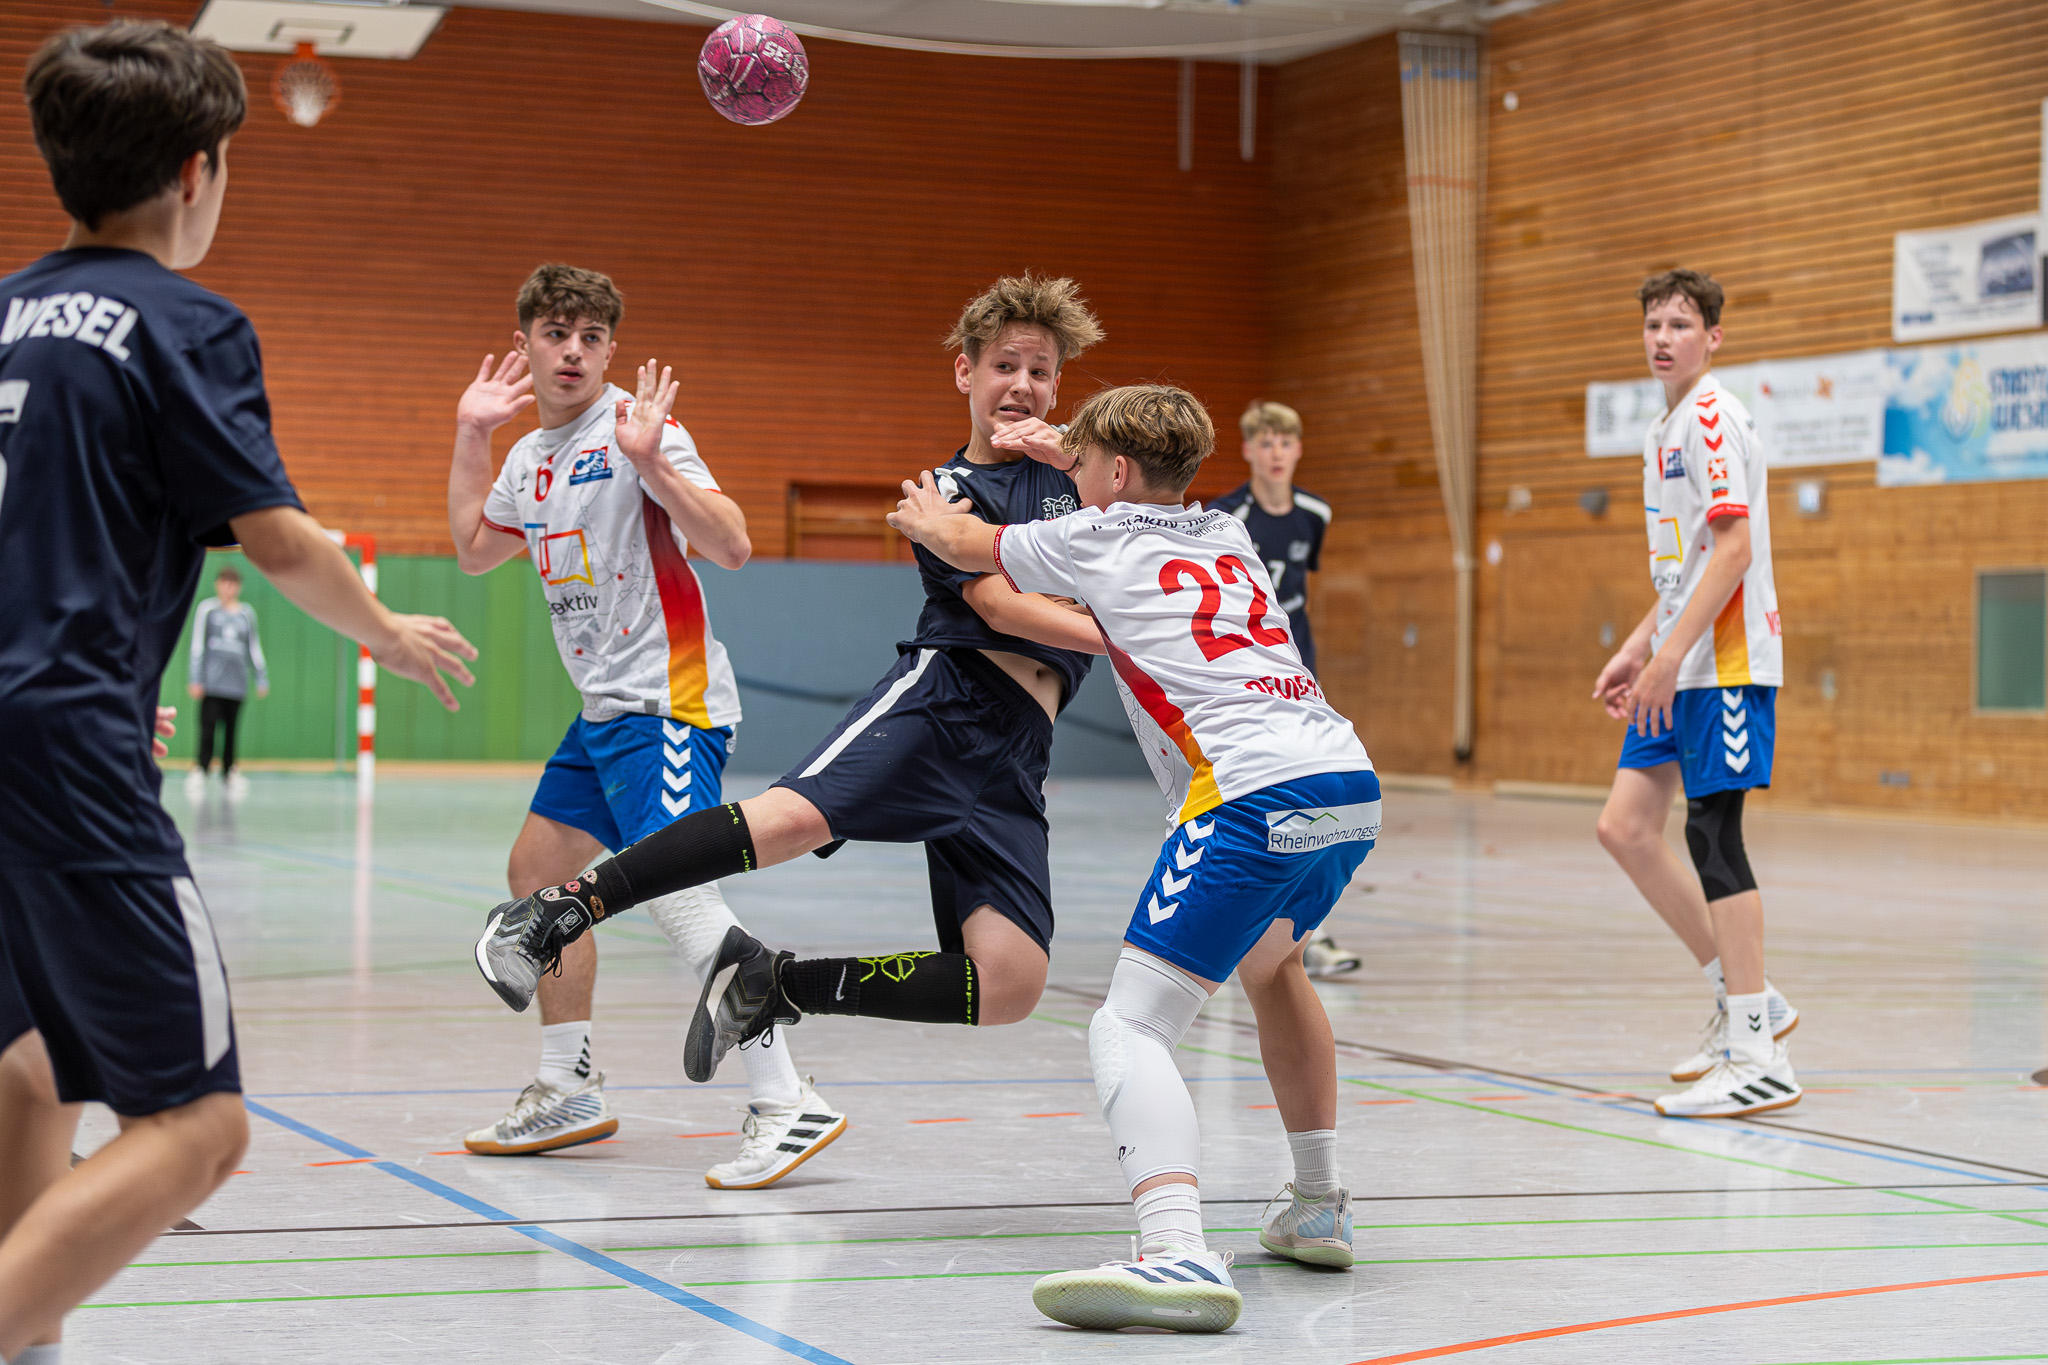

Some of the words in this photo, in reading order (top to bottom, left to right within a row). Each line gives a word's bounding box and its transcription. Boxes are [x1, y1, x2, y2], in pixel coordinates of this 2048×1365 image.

[0, 291, 139, 362] WESEL
[1267, 560, 1286, 591] 7
[1158, 554, 1289, 663] 22
[1337, 1193, 1346, 1225] STABIL
